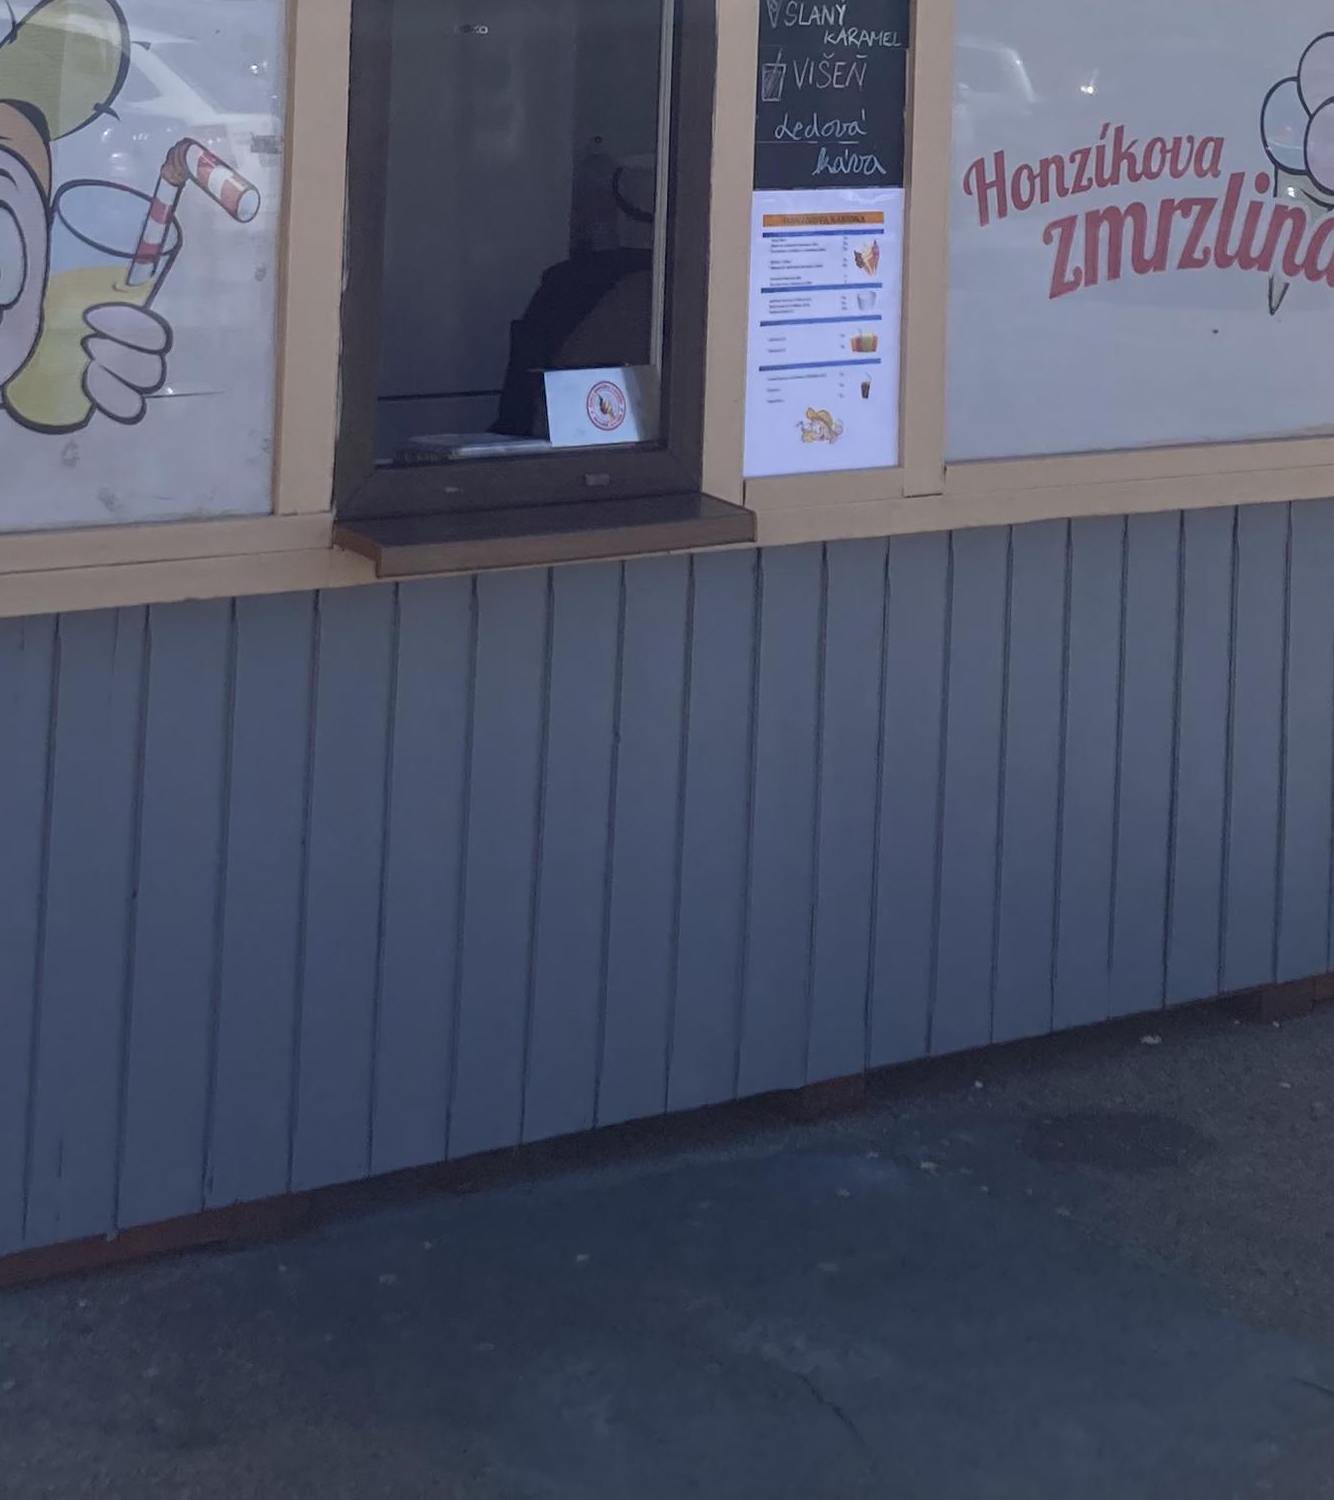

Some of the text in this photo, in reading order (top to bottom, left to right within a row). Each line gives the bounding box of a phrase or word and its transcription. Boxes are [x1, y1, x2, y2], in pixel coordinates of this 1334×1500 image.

[823, 27, 901, 49] KARAMEL
[793, 52, 868, 91] VIŠEŇ
[962, 122, 1225, 227] Honzíkova
